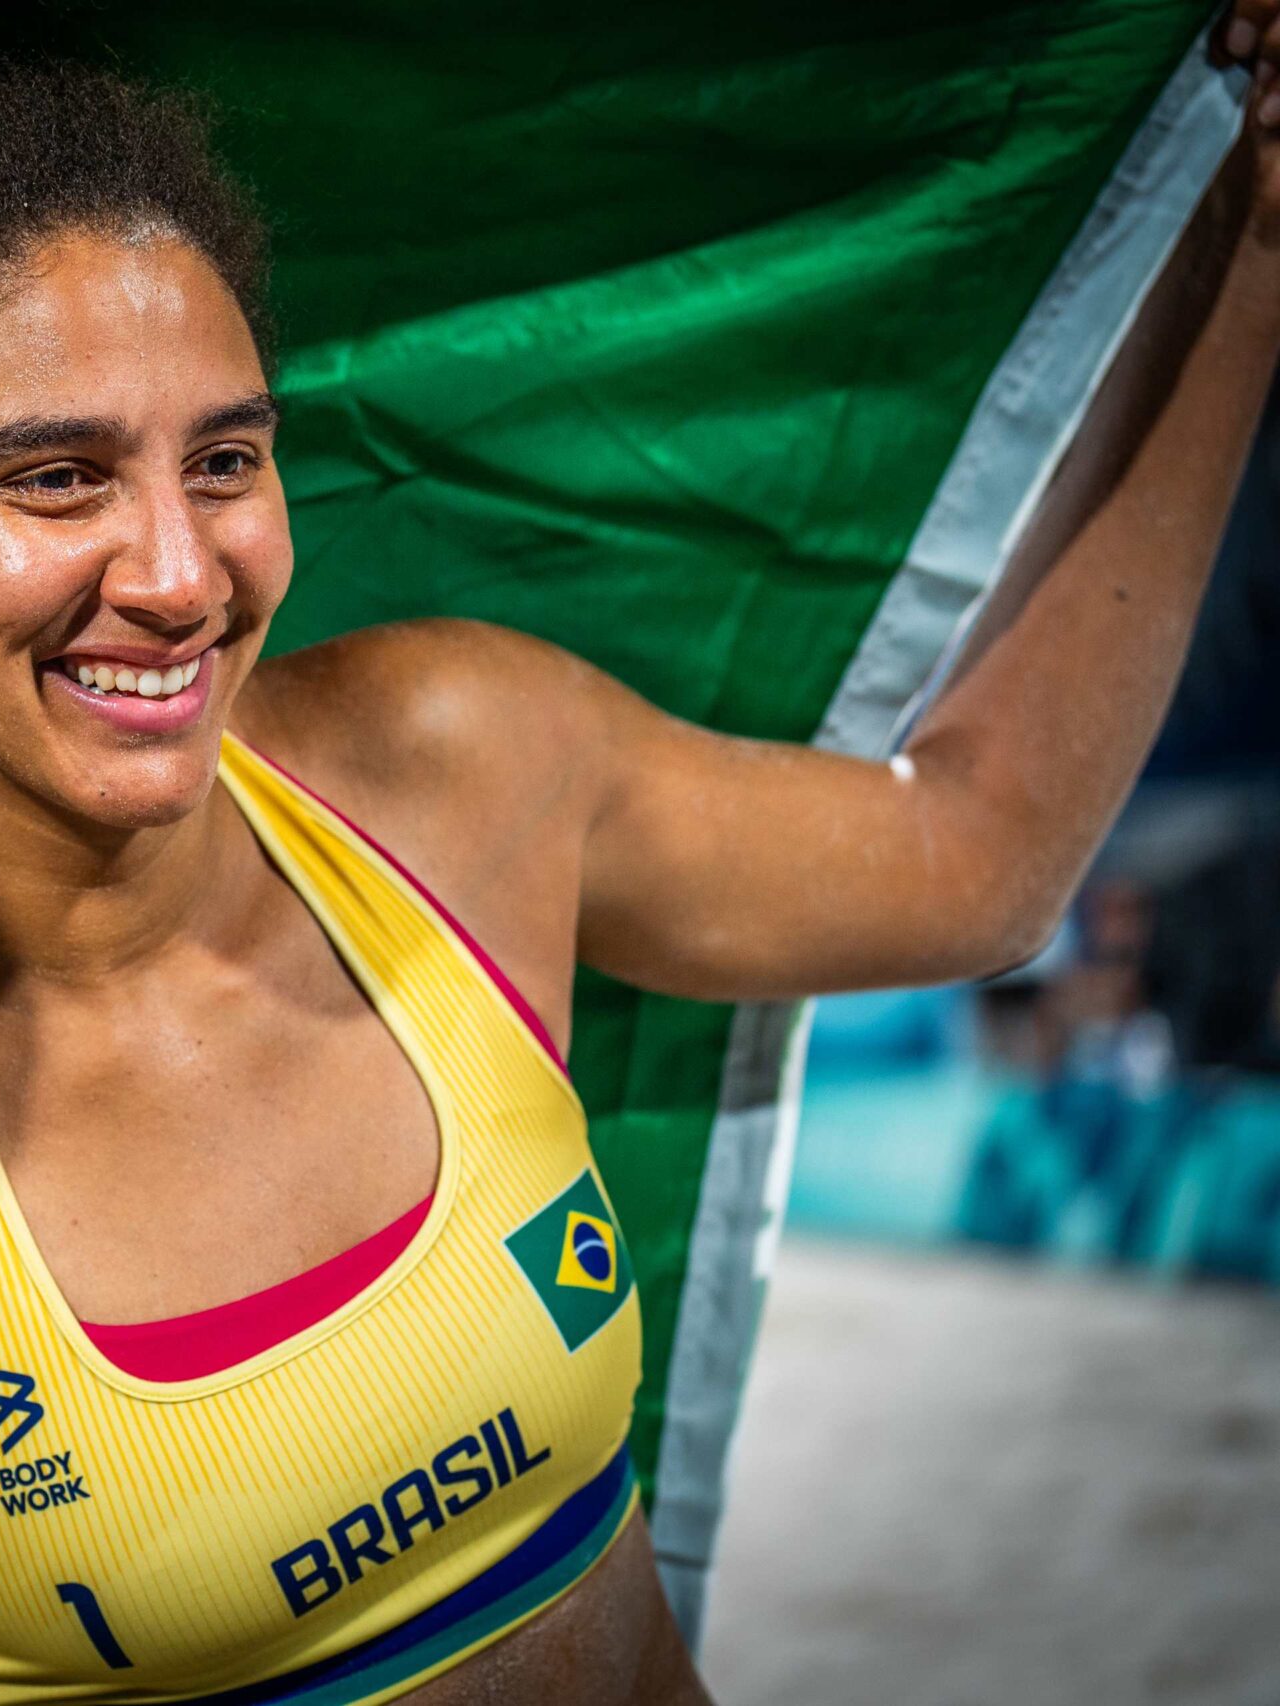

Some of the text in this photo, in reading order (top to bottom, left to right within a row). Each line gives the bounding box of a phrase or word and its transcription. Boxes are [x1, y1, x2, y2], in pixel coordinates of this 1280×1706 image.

[0, 1476, 91, 1517] WORK
[270, 1407, 552, 1618] BRASIL
[55, 1582, 134, 1670] 1
